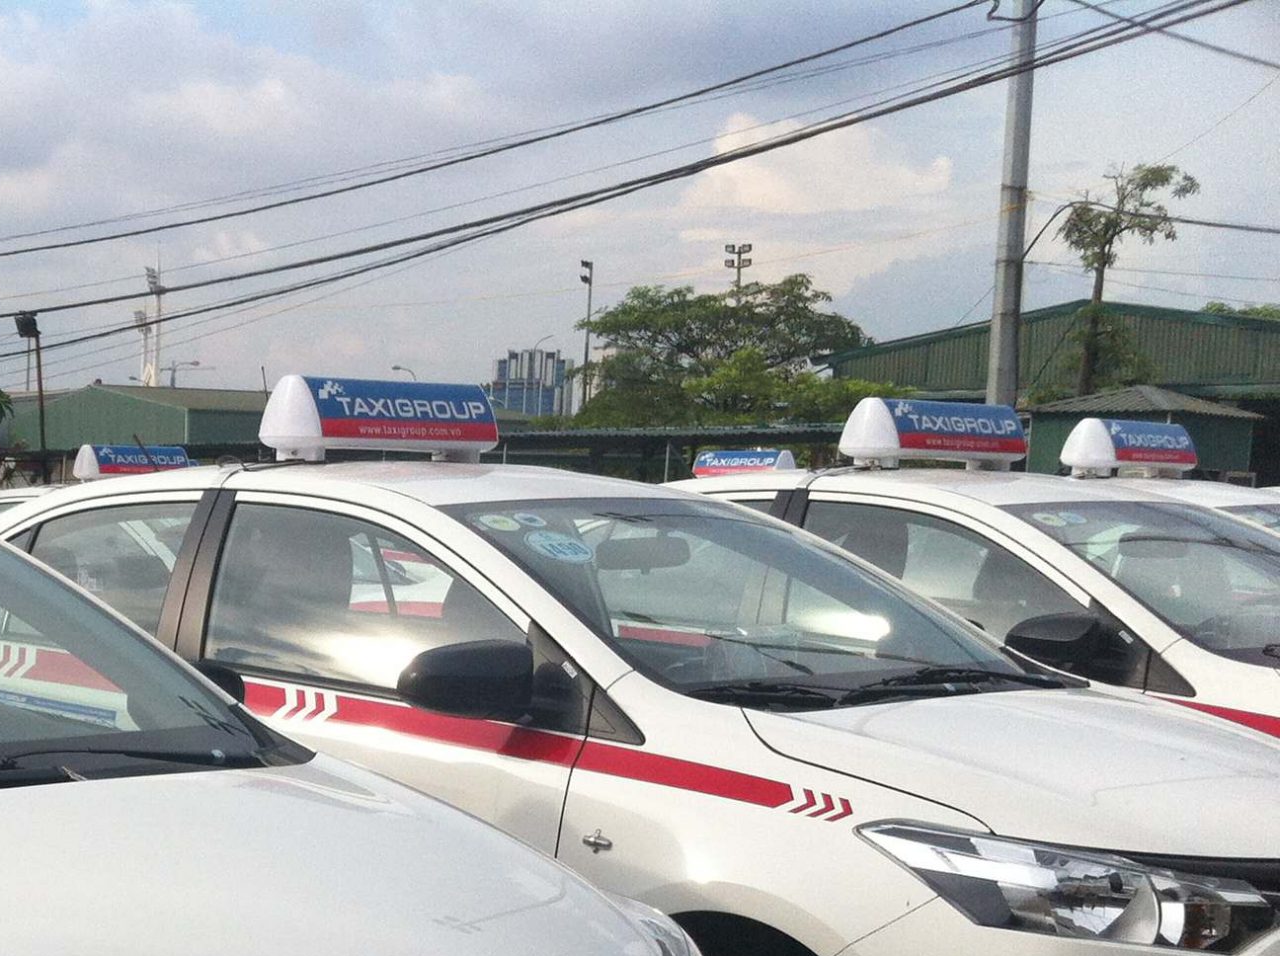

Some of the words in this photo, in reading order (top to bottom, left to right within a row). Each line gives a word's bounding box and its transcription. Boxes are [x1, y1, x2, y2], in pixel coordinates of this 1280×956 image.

[336, 397, 486, 420] TAXIGROUP
[907, 414, 1018, 435] TAXIGROUP
[1119, 433, 1190, 449] TAXIGROUP
[110, 454, 186, 466] TAXIGROUP
[706, 457, 775, 467] TAXIGROUP
